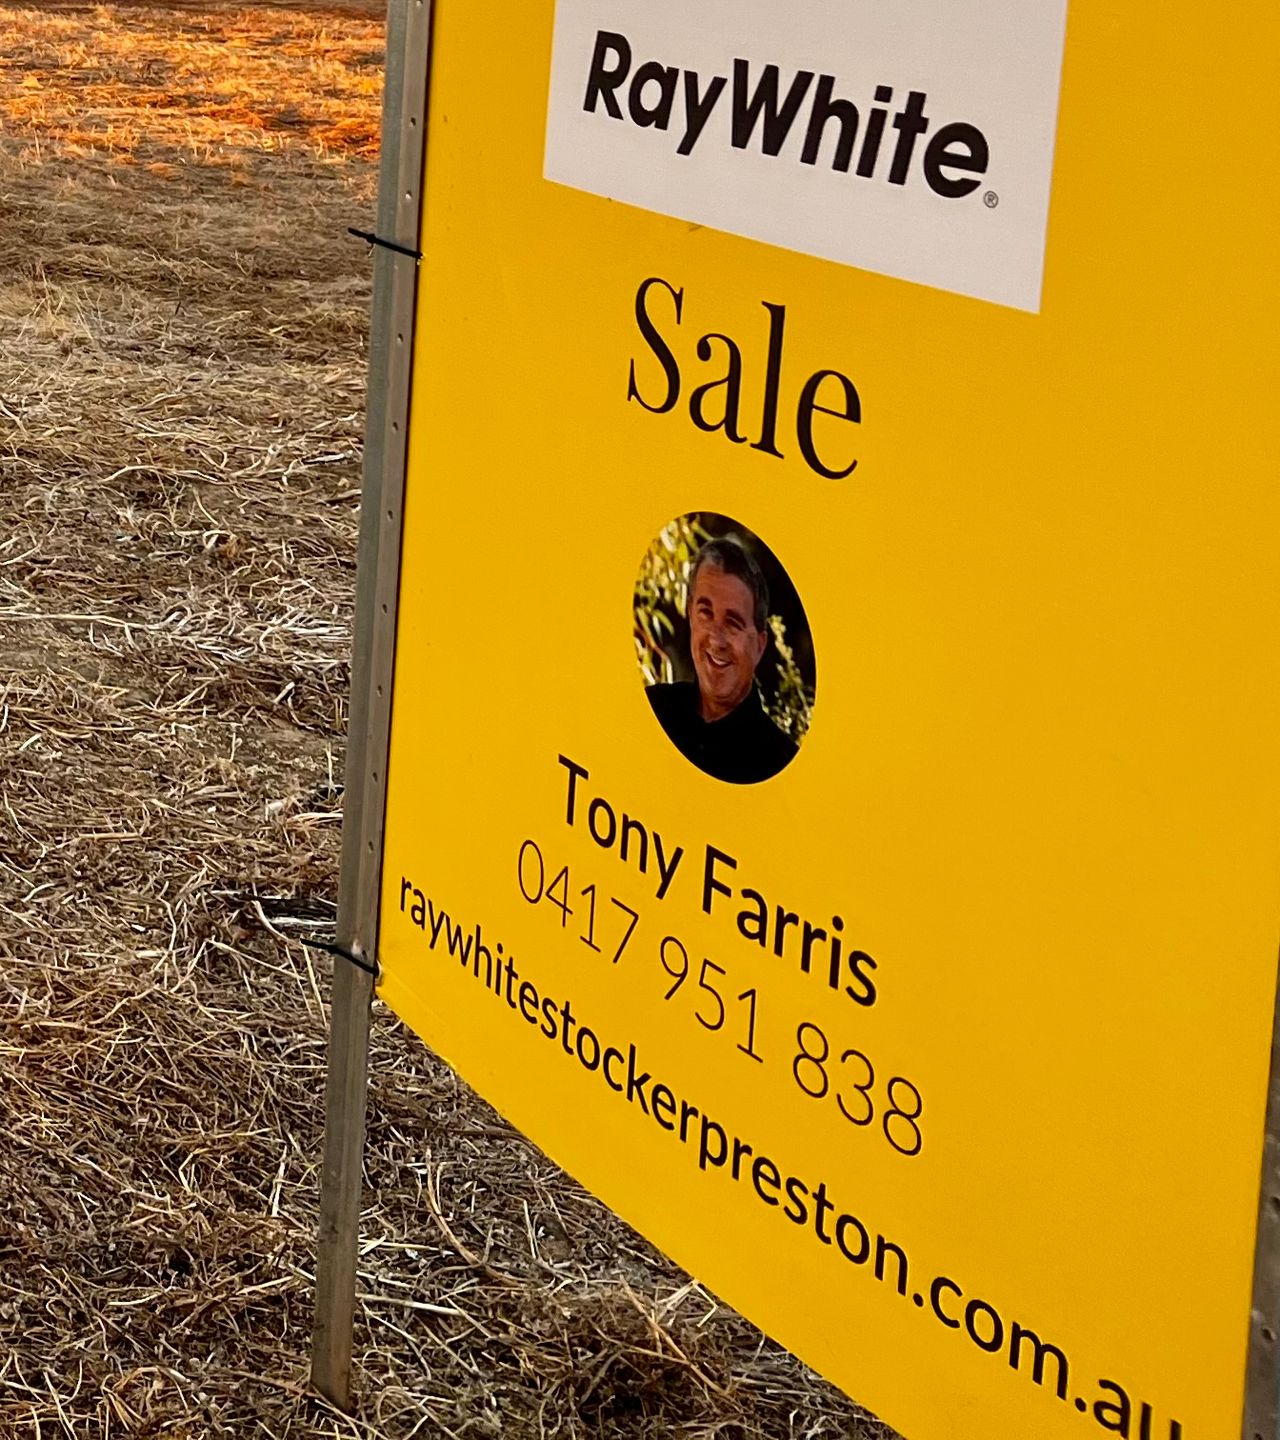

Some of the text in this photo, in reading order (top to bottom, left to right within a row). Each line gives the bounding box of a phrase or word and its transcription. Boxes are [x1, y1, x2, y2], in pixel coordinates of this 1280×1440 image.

[627, 277, 862, 480] Sale
[518, 839, 923, 1157] 0417 951 838
[558, 754, 878, 1007] Tony Farris
